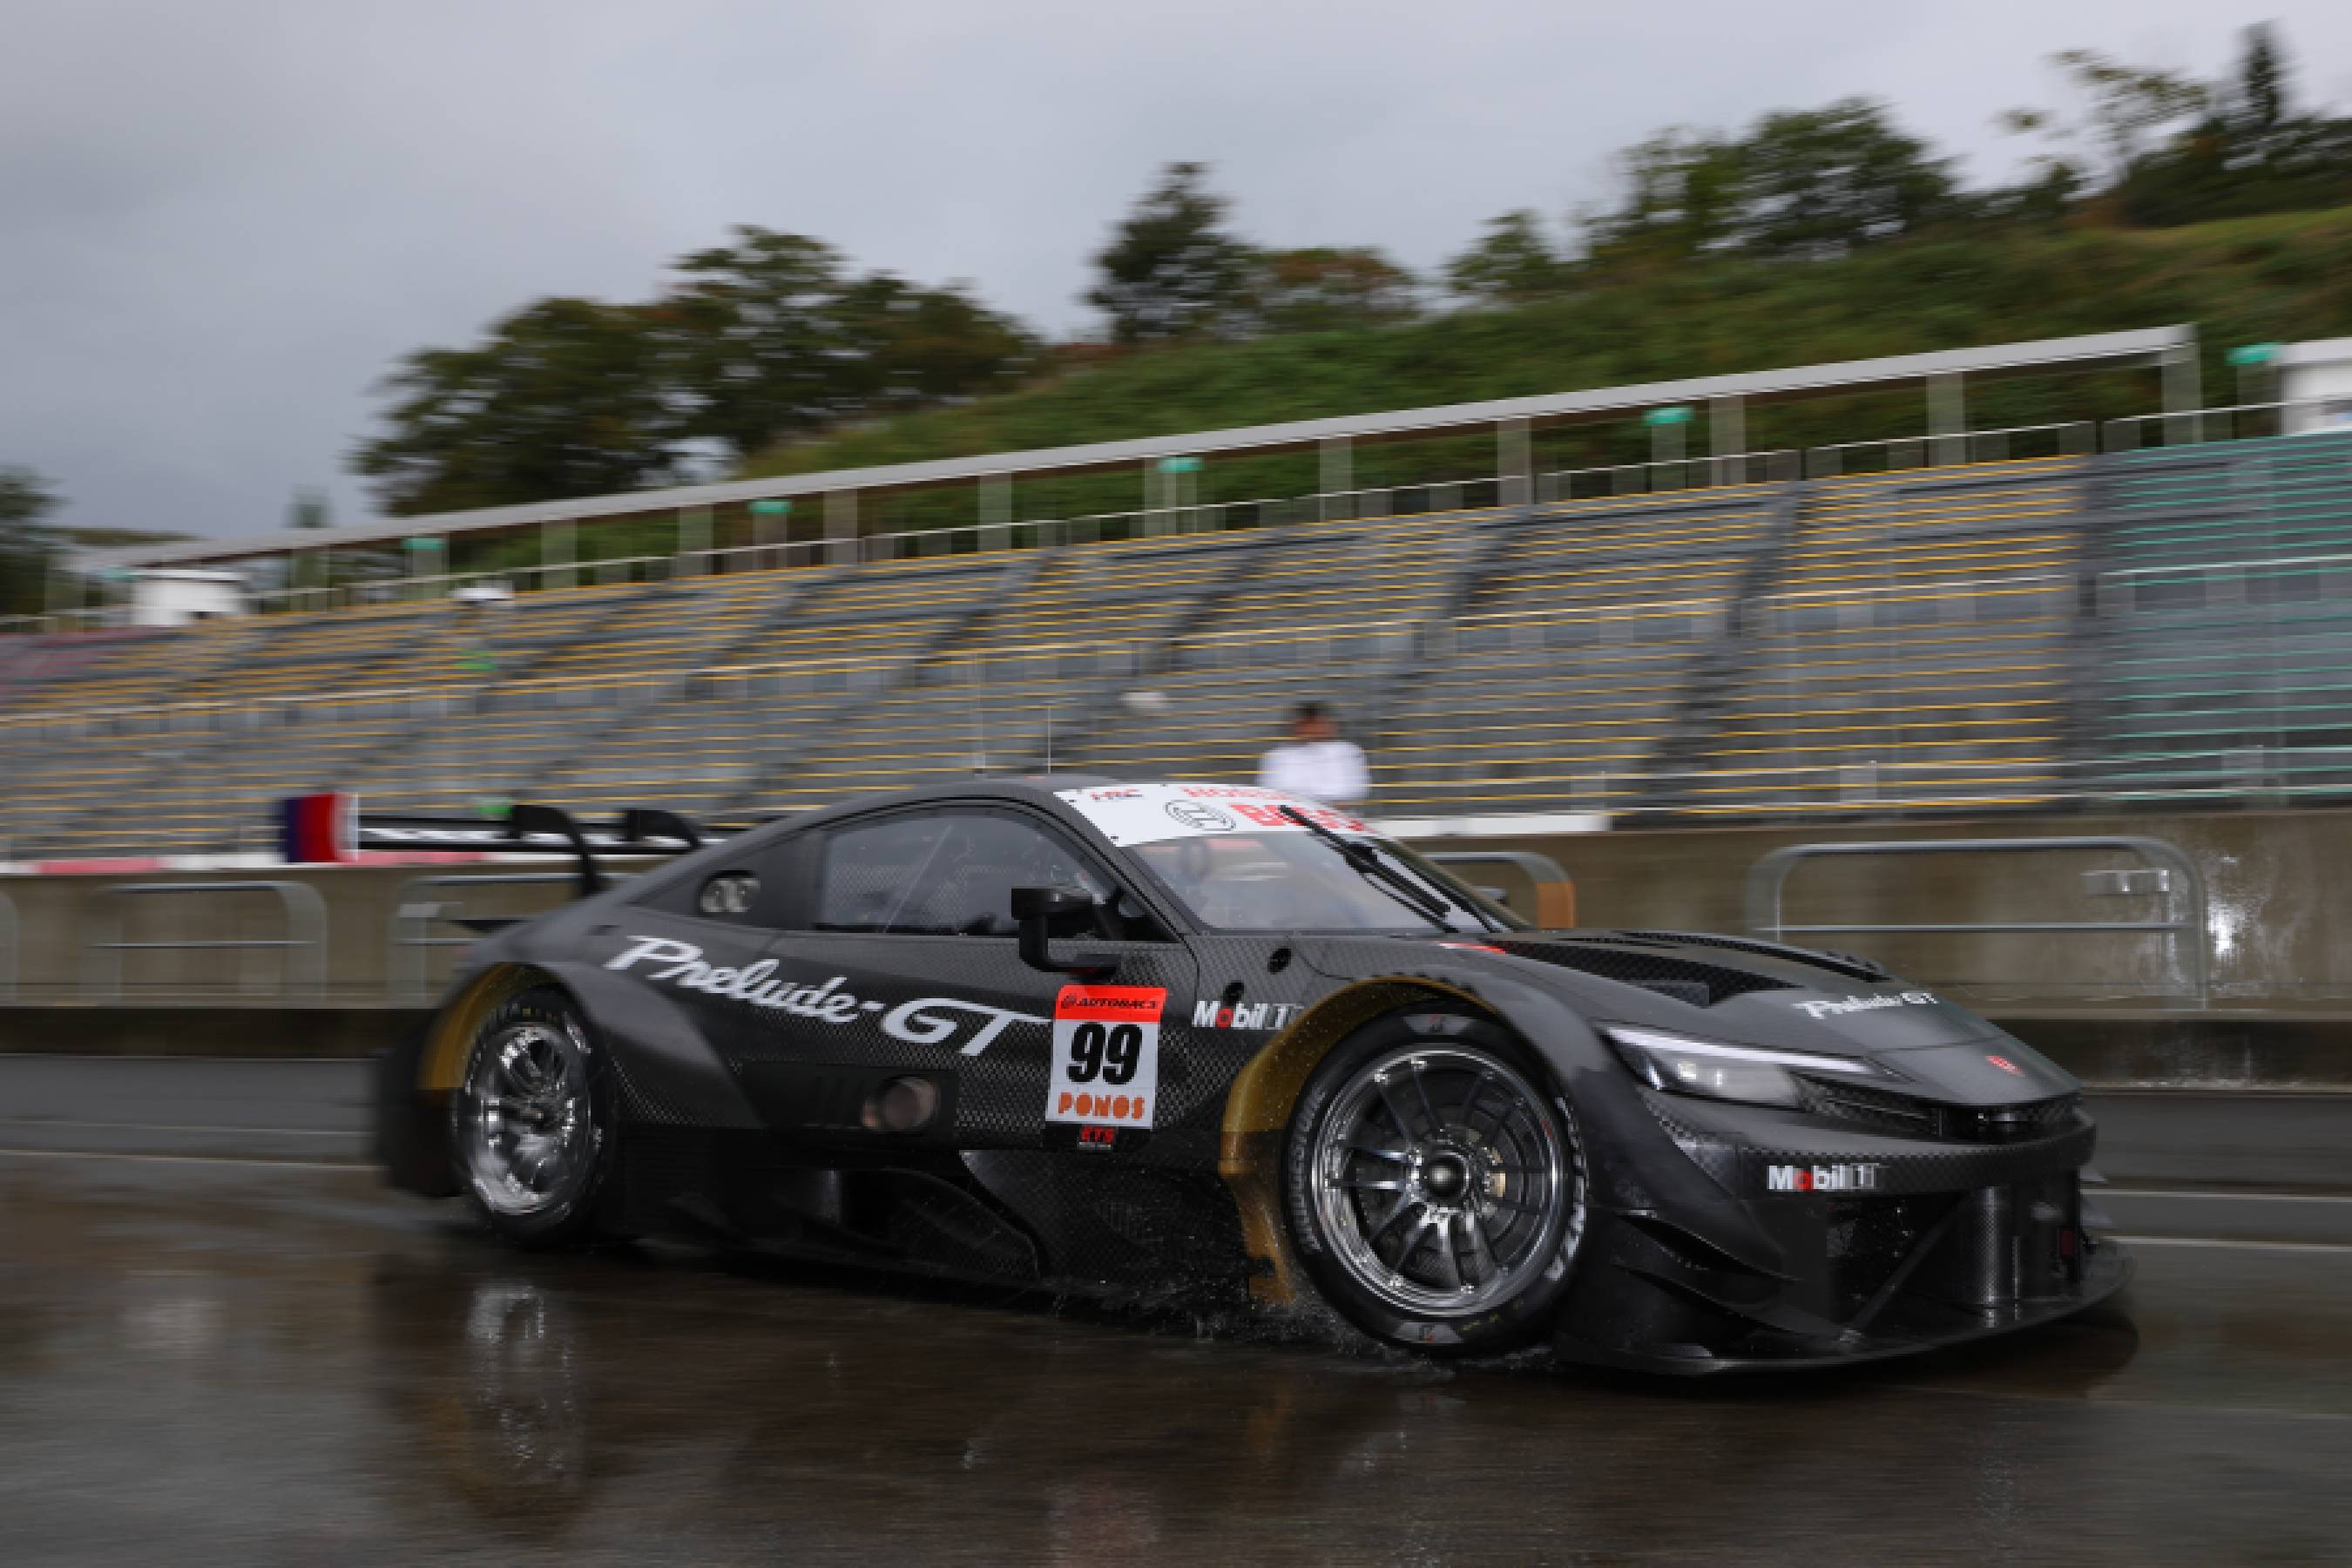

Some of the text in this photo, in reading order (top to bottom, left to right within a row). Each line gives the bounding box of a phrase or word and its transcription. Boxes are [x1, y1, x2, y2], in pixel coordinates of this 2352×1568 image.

[1192, 1000, 1267, 1030] Mobil
[1066, 1022, 1143, 1085] 99
[1058, 1092, 1146, 1119] PONOS
[1768, 1163, 1845, 1192] Mobil
